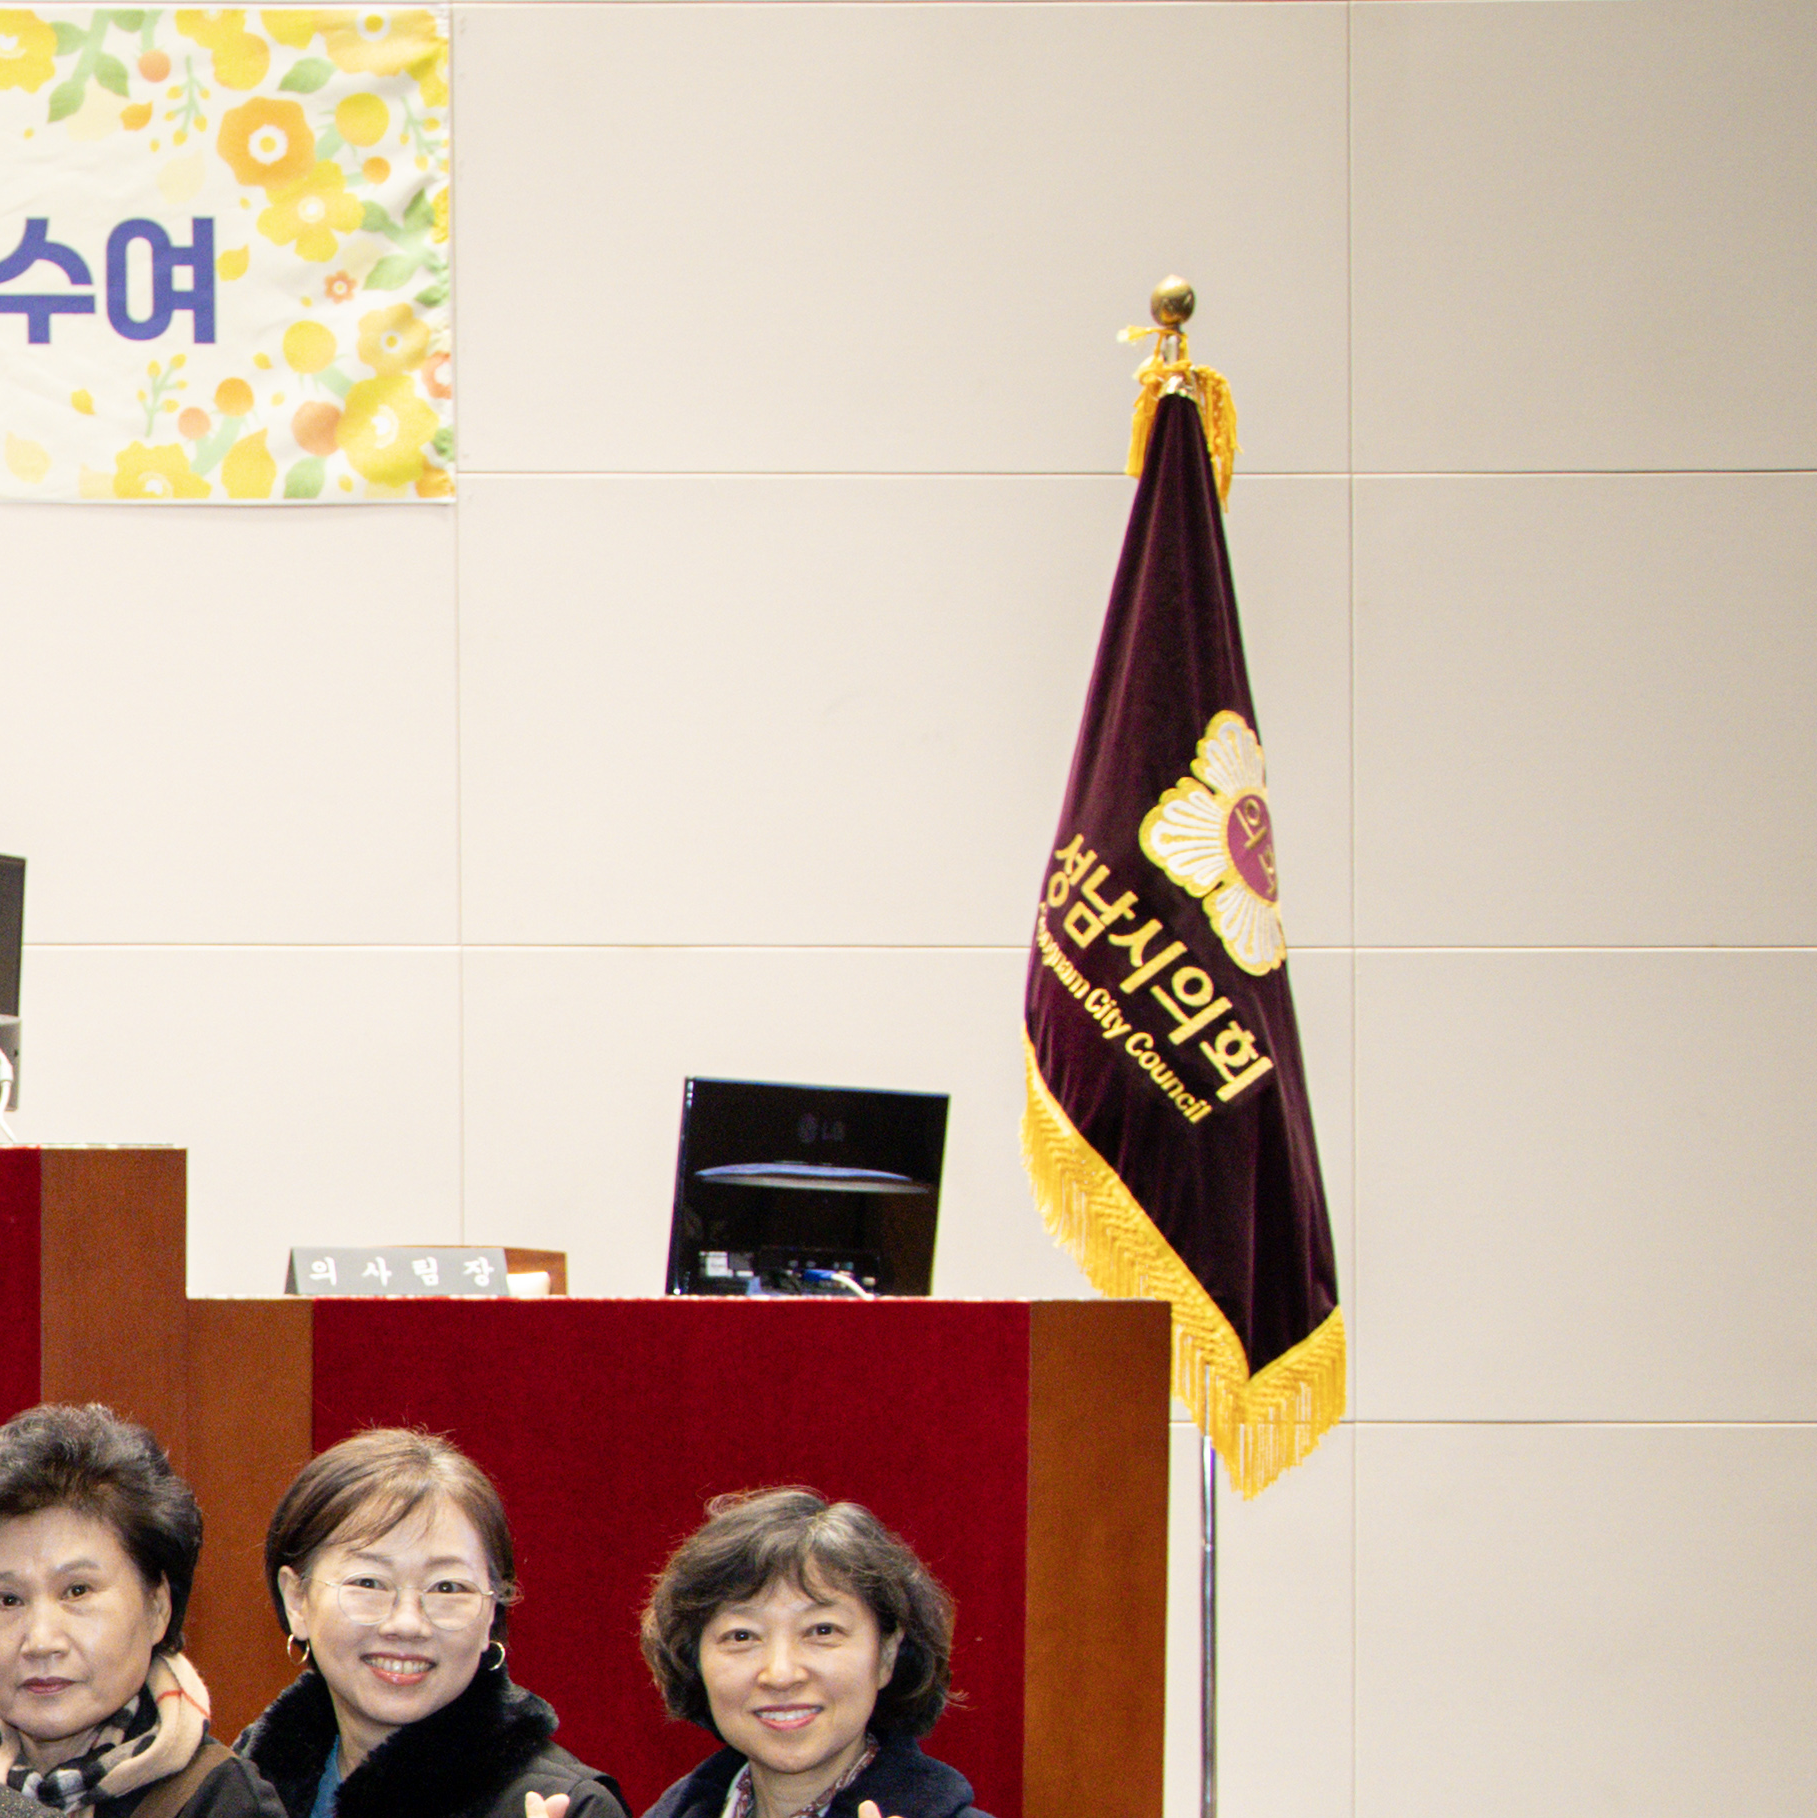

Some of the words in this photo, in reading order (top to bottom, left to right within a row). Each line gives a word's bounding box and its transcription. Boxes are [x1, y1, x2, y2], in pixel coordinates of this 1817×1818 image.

[1046, 833, 1274, 1102] 성남시의회
[1083, 987, 1133, 1040] City
[1124, 1031, 1214, 1125] Council
